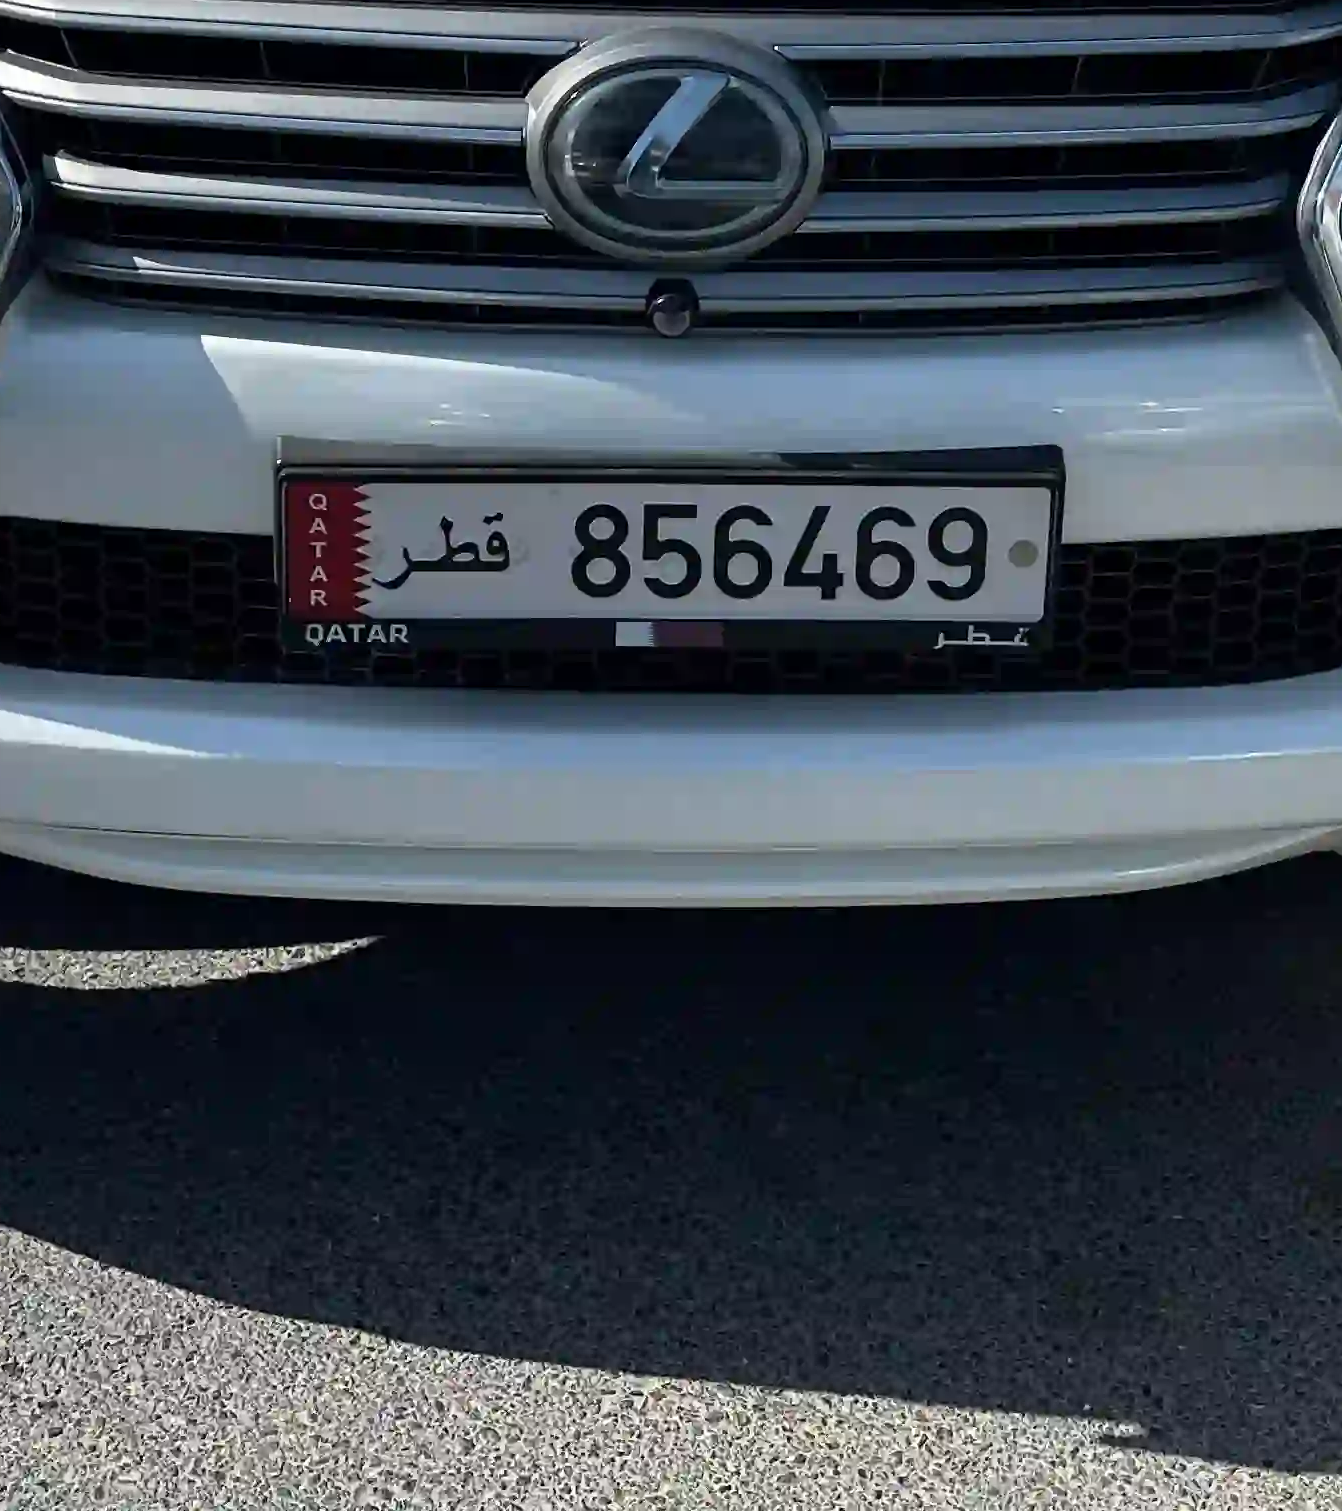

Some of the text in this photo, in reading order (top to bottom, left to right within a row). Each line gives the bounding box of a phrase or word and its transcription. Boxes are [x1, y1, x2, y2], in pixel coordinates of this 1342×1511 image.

[308, 493, 329, 607] QATAR
[371, 511, 511, 591] قطر
[570, 503, 989, 601] 856469
[305, 622, 410, 647] QATAR
[932, 624, 1031, 651] قطر
